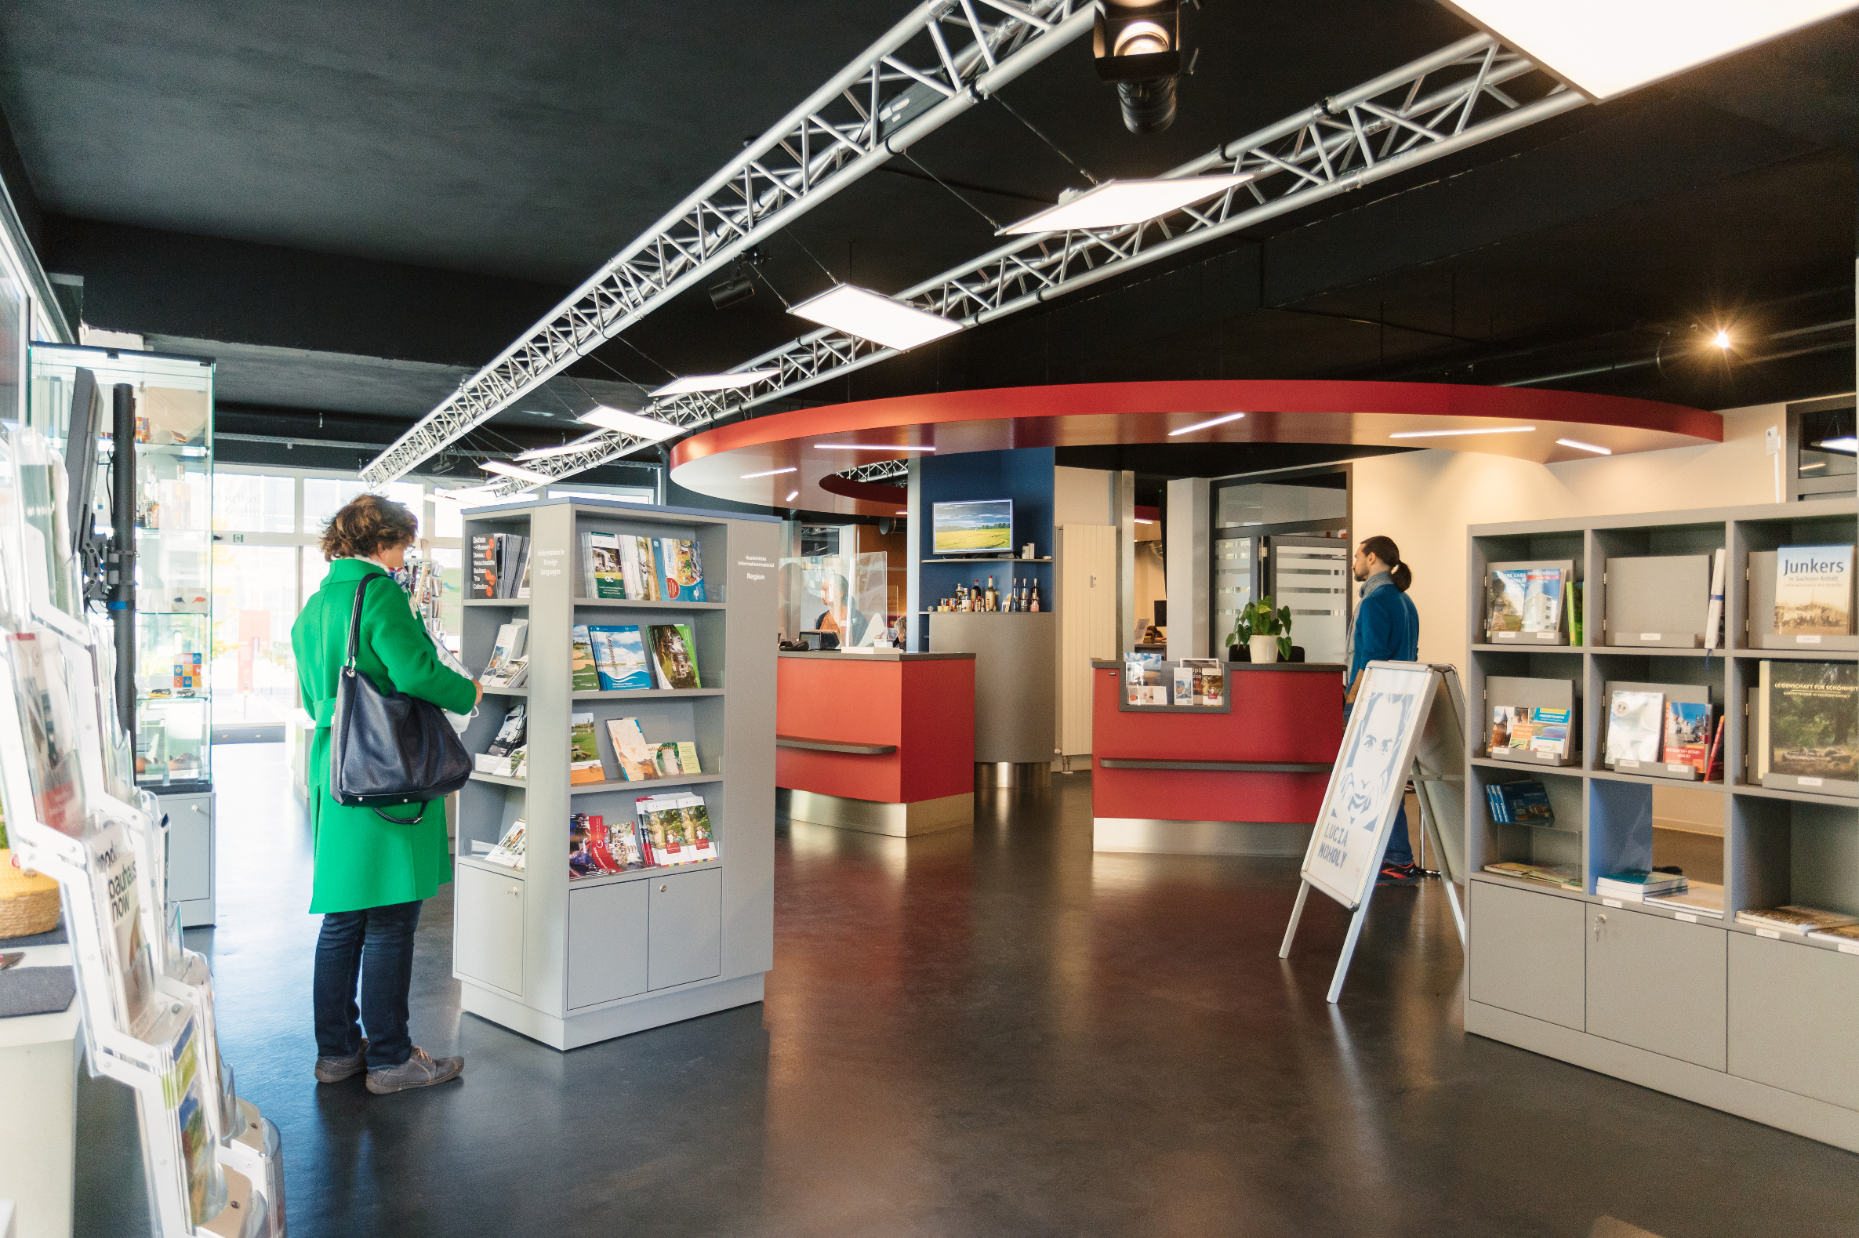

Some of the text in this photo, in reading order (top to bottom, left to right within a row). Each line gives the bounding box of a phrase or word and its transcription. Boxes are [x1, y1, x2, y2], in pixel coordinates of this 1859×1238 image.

[537, 549, 561, 557] Information
[543, 558, 558, 567] foreign
[1783, 557, 1845, 577] Junkers
[540, 568, 561, 577] languages
[746, 572, 765, 581] Region
[1774, 682, 1813, 690] LEIDENSCHAFT
[1825, 684, 1859, 692] SCHÖNHEIT
[1323, 821, 1349, 847] LUCIA
[1317, 841, 1348, 870] MOHOLY
[111, 891, 131, 923] now
